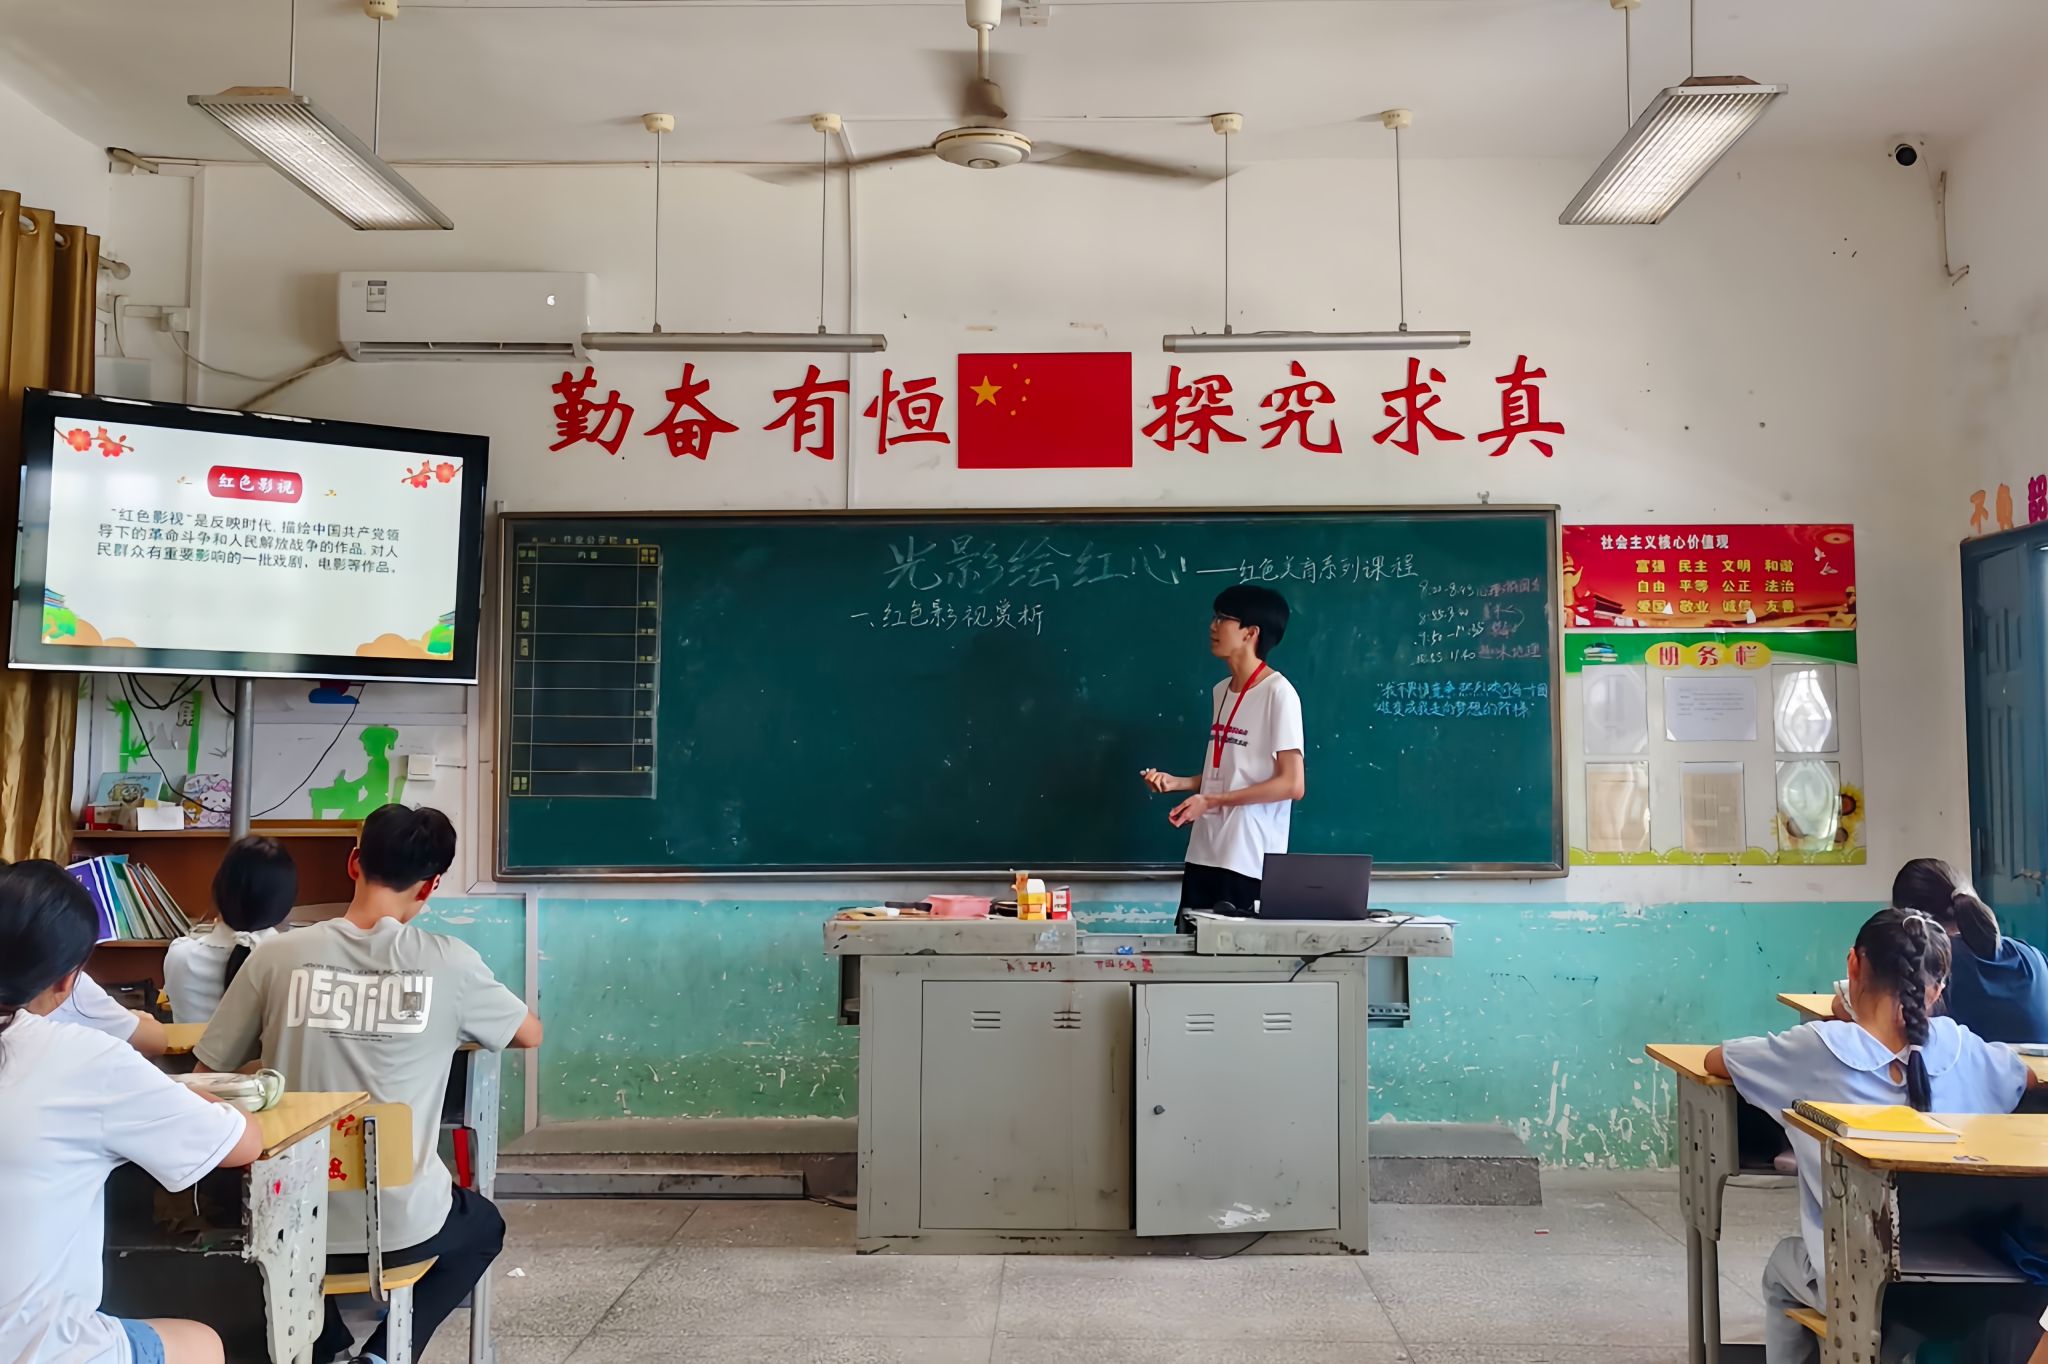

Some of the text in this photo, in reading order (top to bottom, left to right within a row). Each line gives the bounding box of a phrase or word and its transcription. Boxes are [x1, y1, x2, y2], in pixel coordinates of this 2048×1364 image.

[549, 354, 1566, 460] 勤奋有恒 探究求真
[218, 472, 295, 495] 红色影视
[1600, 534, 1729, 550] 社会主义核心价值观
[1636, 559, 1794, 573] 富强 民主 文明 和谐
[1637, 579, 1795, 593] 自由 平等 公正 法治
[1636, 599, 1795, 614] 爱国 敬业 诚信 友善
[851, 599, 1045, 636] 一、红色影视赏析
